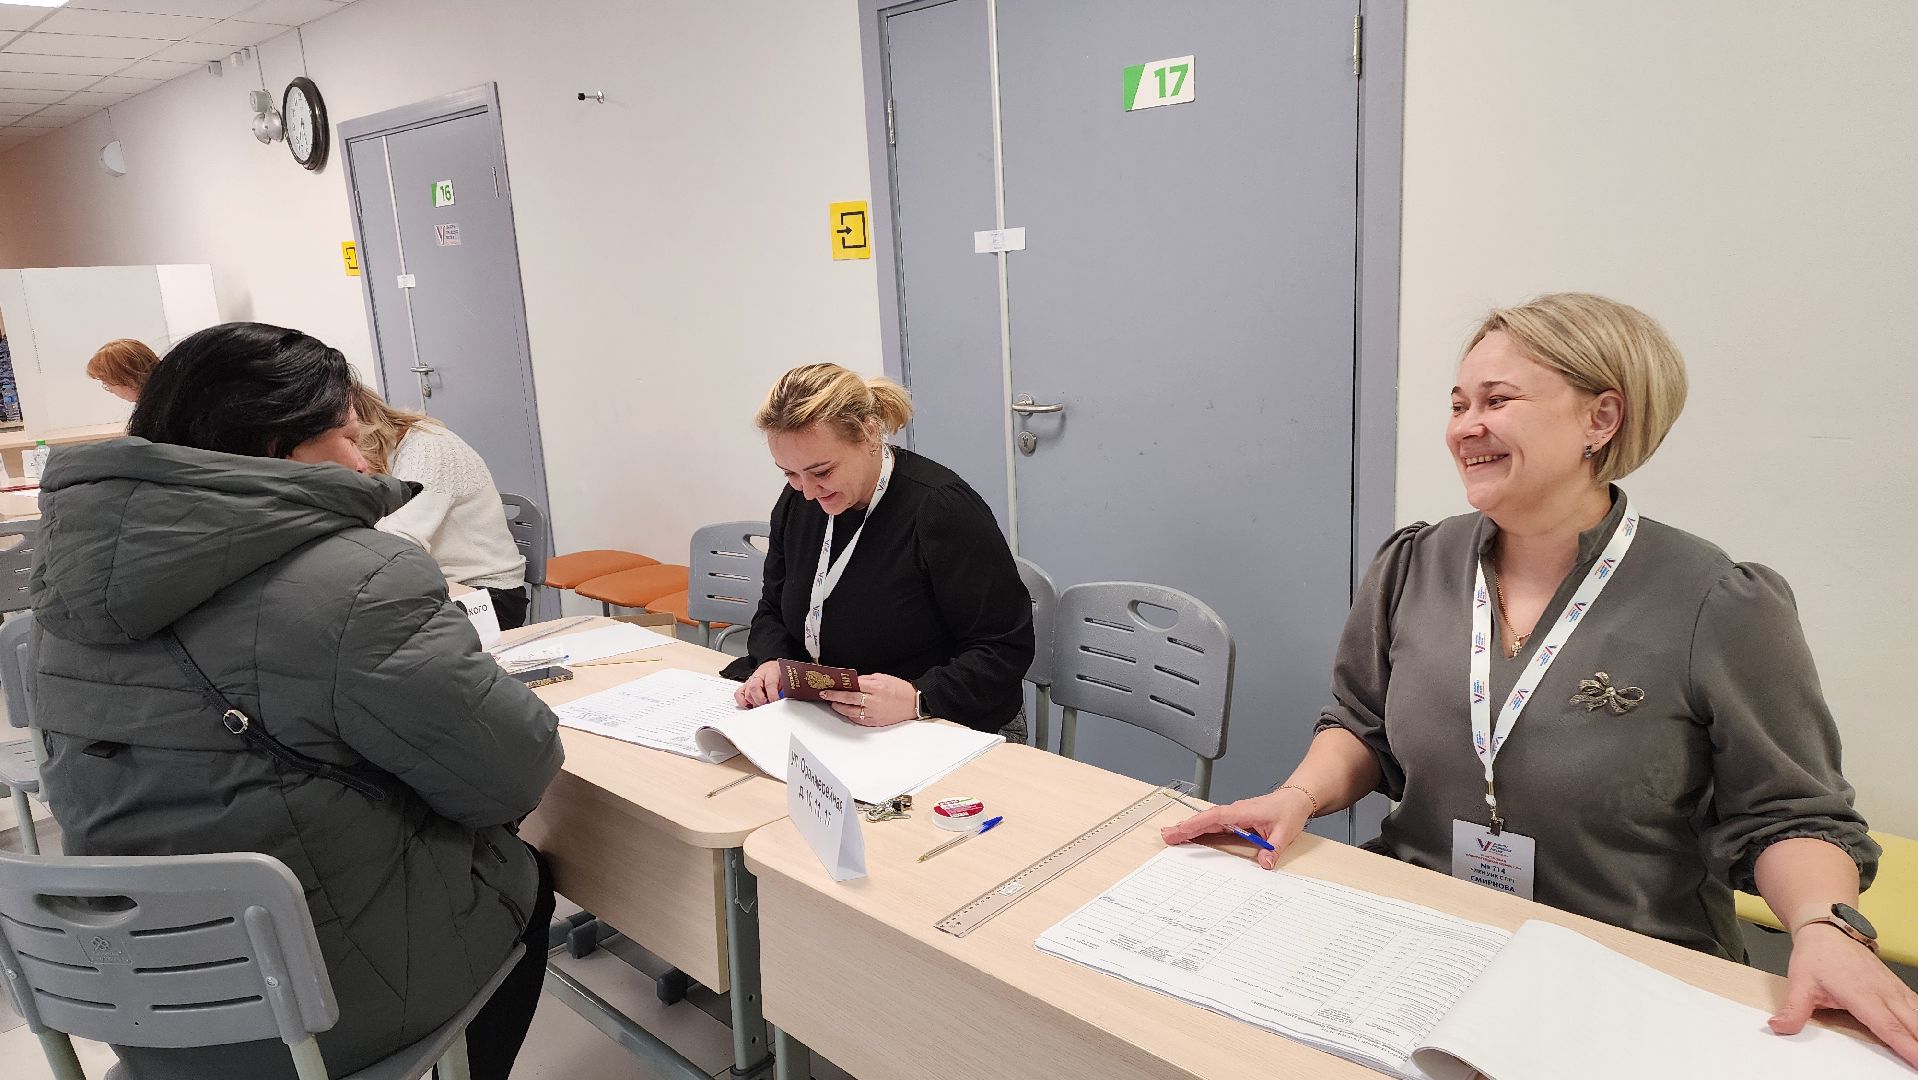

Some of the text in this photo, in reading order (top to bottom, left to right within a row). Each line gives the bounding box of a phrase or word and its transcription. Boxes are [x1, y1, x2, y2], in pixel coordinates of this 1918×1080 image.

[1153, 63, 1189, 99] 17
[439, 184, 452, 201] 16
[468, 603, 488, 617] кого
[1492, 866, 1506, 874] 714
[1470, 875, 1516, 892] СМИРНОВА
